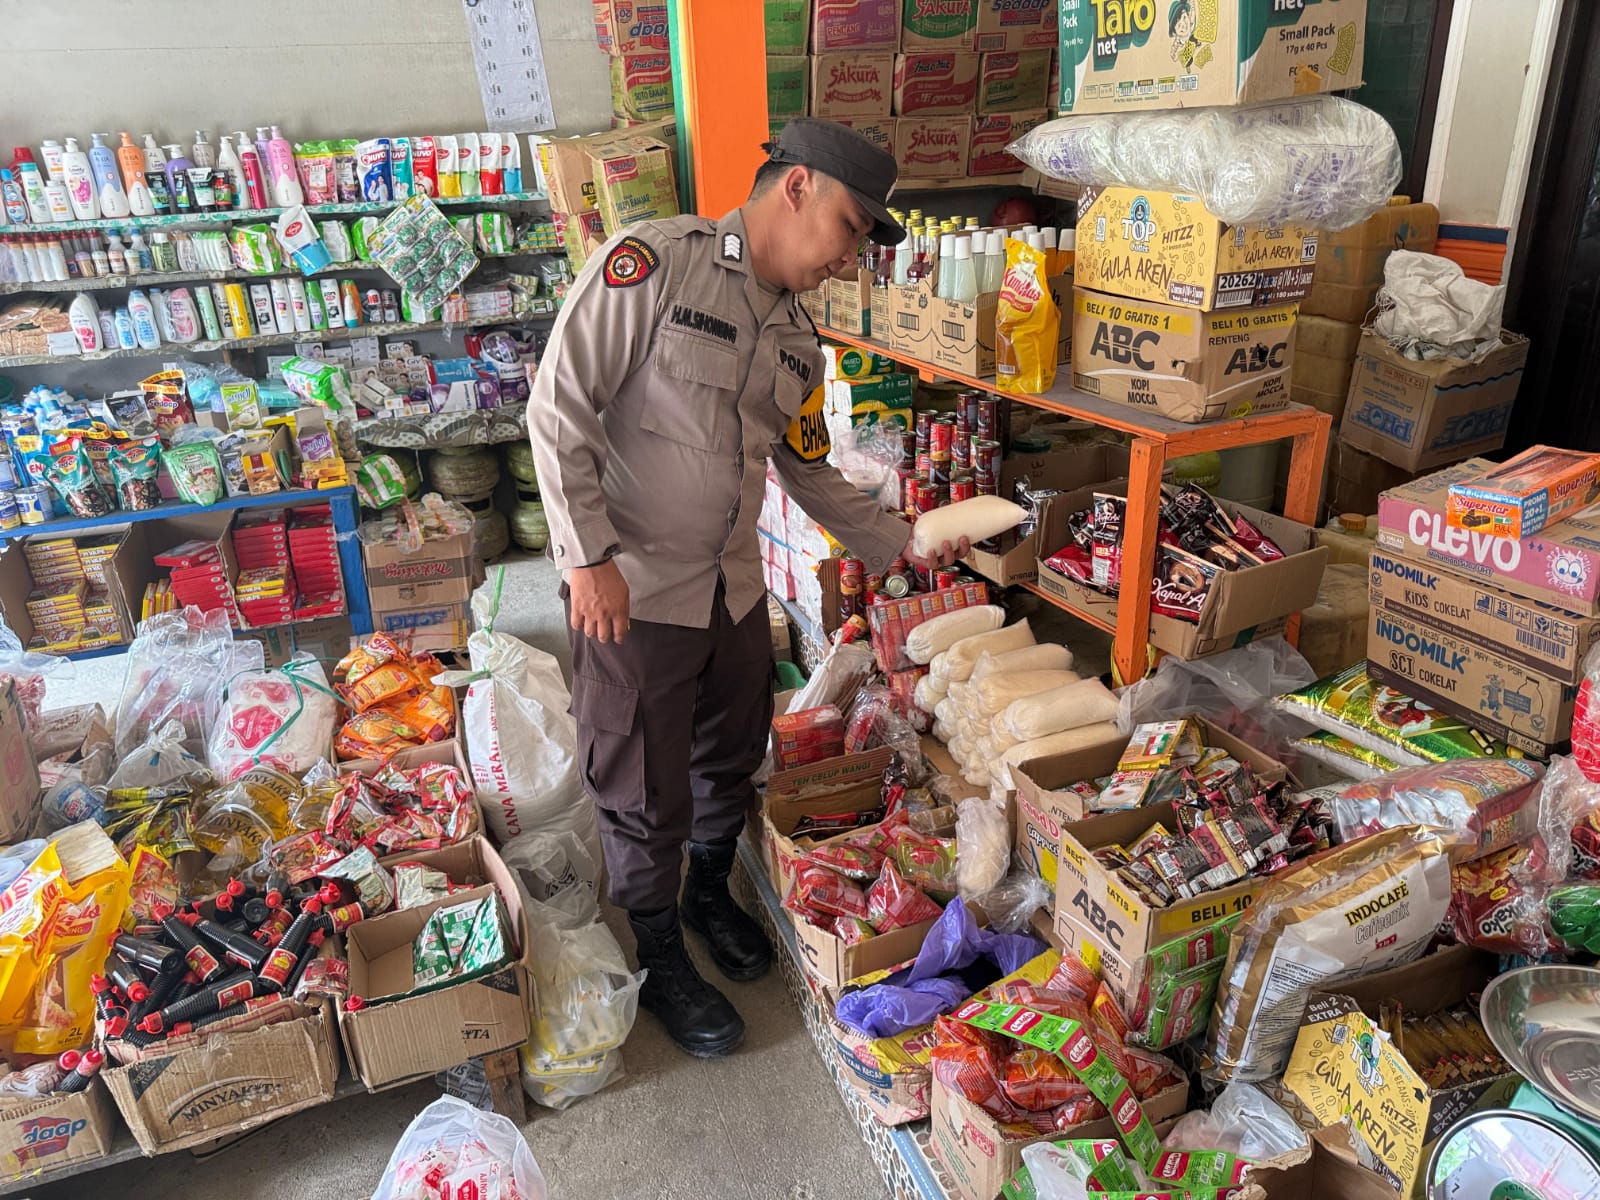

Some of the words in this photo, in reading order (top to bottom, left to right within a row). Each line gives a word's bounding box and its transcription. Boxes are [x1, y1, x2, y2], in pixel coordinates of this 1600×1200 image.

[630, 22, 669, 38] aap
[1062, 13, 1078, 28] Pack
[1091, 0, 1155, 38] Taro
[1280, 26, 1309, 41] Small
[1311, 23, 1336, 37] Pack
[1097, 38, 1117, 56] net
[1286, 45, 1299, 55] 17g
[1306, 42, 1315, 51] 40
[1316, 42, 1328, 50] Pcs
[1121, 218, 1156, 242] TOP
[1162, 224, 1194, 244] HITZZ
[1245, 247, 1268, 264] GULA
[1270, 245, 1295, 260] AREN
[1304, 245, 1315, 257] 10
[1101, 256, 1131, 283] GULA
[1135, 257, 1173, 290] AREN
[1086, 302, 1105, 317] BELI
[1108, 304, 1121, 320] 10
[1124, 310, 1159, 326] GRATIS
[1163, 316, 1170, 330] 1
[1212, 319, 1233, 330] BELI
[1236, 317, 1249, 329] 10
[1253, 313, 1288, 326] GRATIS
[1090, 322, 1161, 371] ABC
[1208, 333, 1250, 346] RENTENG
[779, 349, 812, 383] POLRI
[1131, 377, 1150, 391] KOPI
[1127, 391, 1158, 407] MOCCA
[1555, 471, 1598, 498] Superstar
[1457, 498, 1509, 515] Superstar
[1523, 492, 1547, 508] PROMO
[1524, 505, 1544, 520] 20+1
[1373, 555, 1438, 591] INDOMILK
[1151, 577, 1192, 603] Kapal
[1434, 601, 1471, 620] COKELAT
[1376, 618, 1467, 675] INDOMILK
[1391, 651, 1414, 677] SCI
[1419, 668, 1457, 692] COKELAT
[810, 768, 840, 784] CELUP
[842, 761, 872, 774] WANGI
[1072, 888, 1125, 951] ABC
[1191, 902, 1227, 924] BELI
[1232, 894, 1252, 912] 10
[1355, 900, 1411, 945] Coffeemix
[1102, 949, 1119, 966] KOPI
[1307, 1007, 1341, 1024] EXTRA
[1343, 1002, 1350, 1011] 1
[1309, 1001, 1329, 1014] Beli
[1328, 997, 1339, 1007] 2
[69, 1029, 83, 1037] 2L
[1351, 1036, 1384, 1088] TOP
[1315, 1060, 1351, 1106] GULA
[1353, 1099, 1396, 1158] AREN
[1433, 1102, 1454, 1122] Beli
[1453, 1090, 1463, 1099] 2
[1379, 1101, 1418, 1135] HITZZ
[1433, 1102, 1468, 1136] EXTRA
